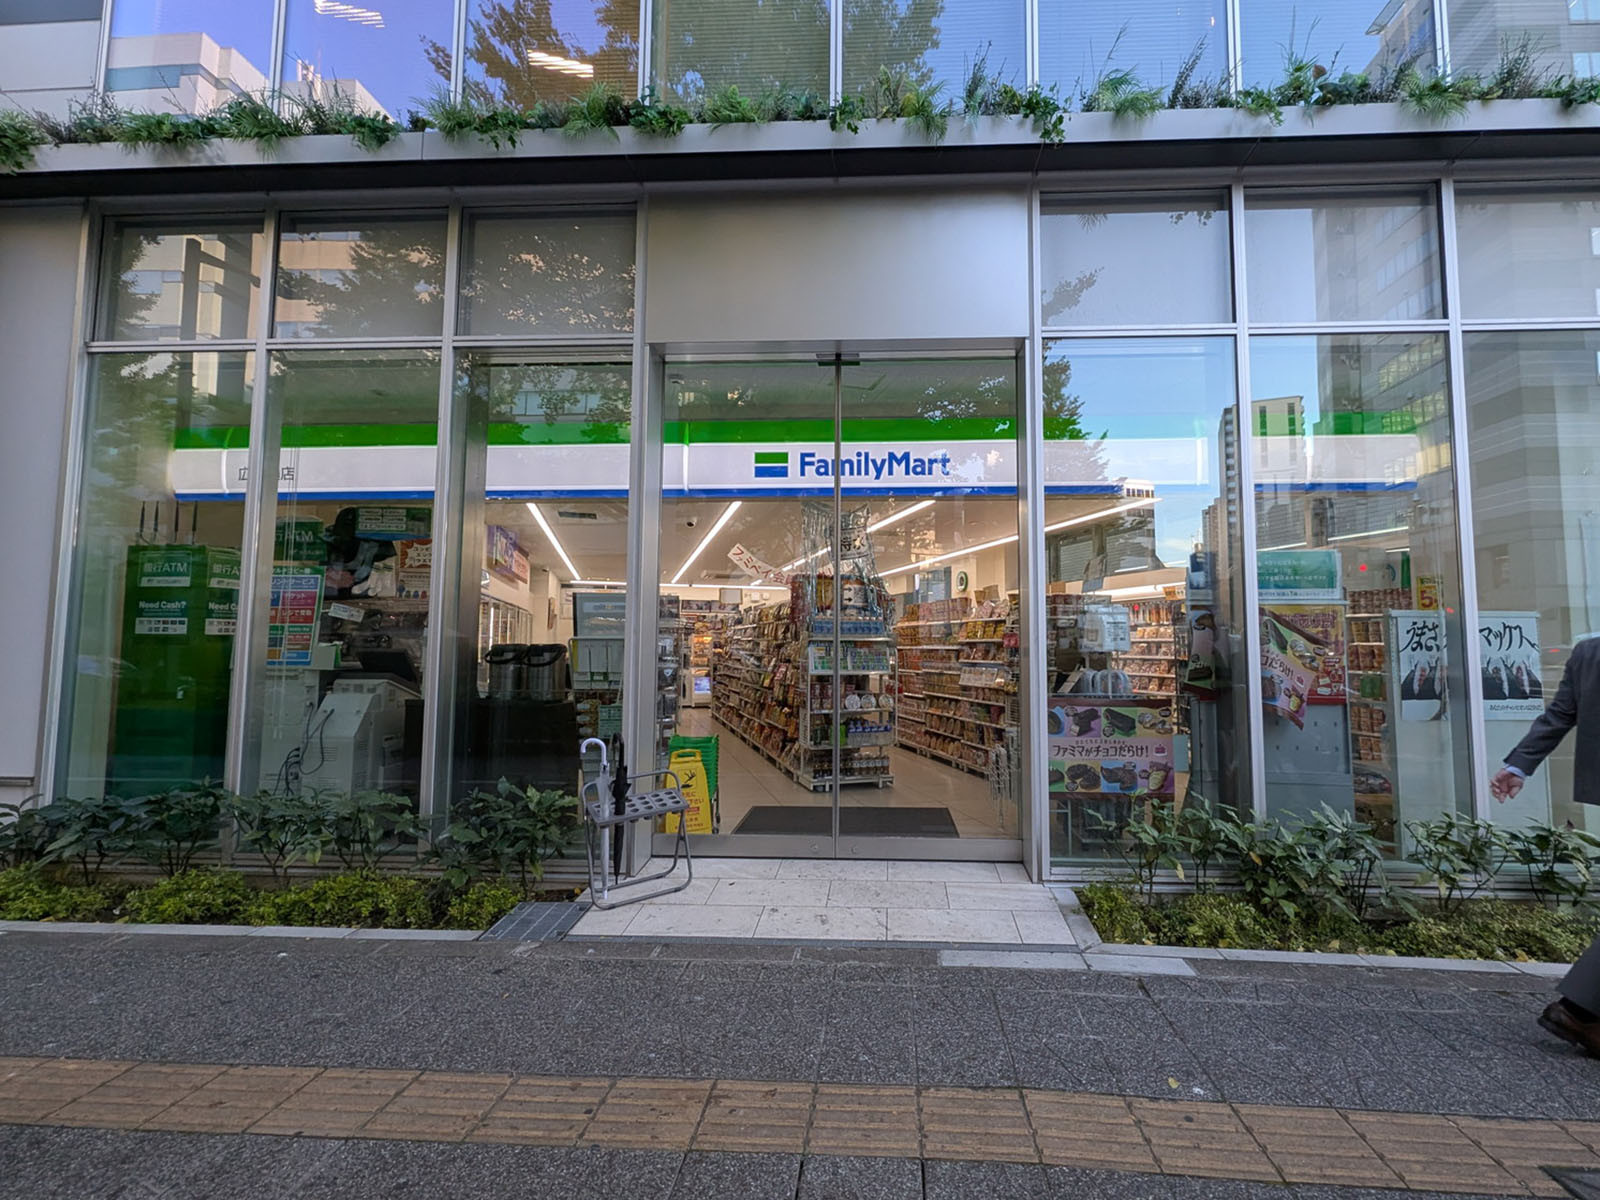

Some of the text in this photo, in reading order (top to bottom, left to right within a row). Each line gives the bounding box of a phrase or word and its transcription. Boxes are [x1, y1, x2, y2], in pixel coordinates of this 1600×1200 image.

[799, 451, 950, 480] FamilyMart
[238, 466, 294, 481] 広店
[138, 600, 186, 609] Need Cash?
